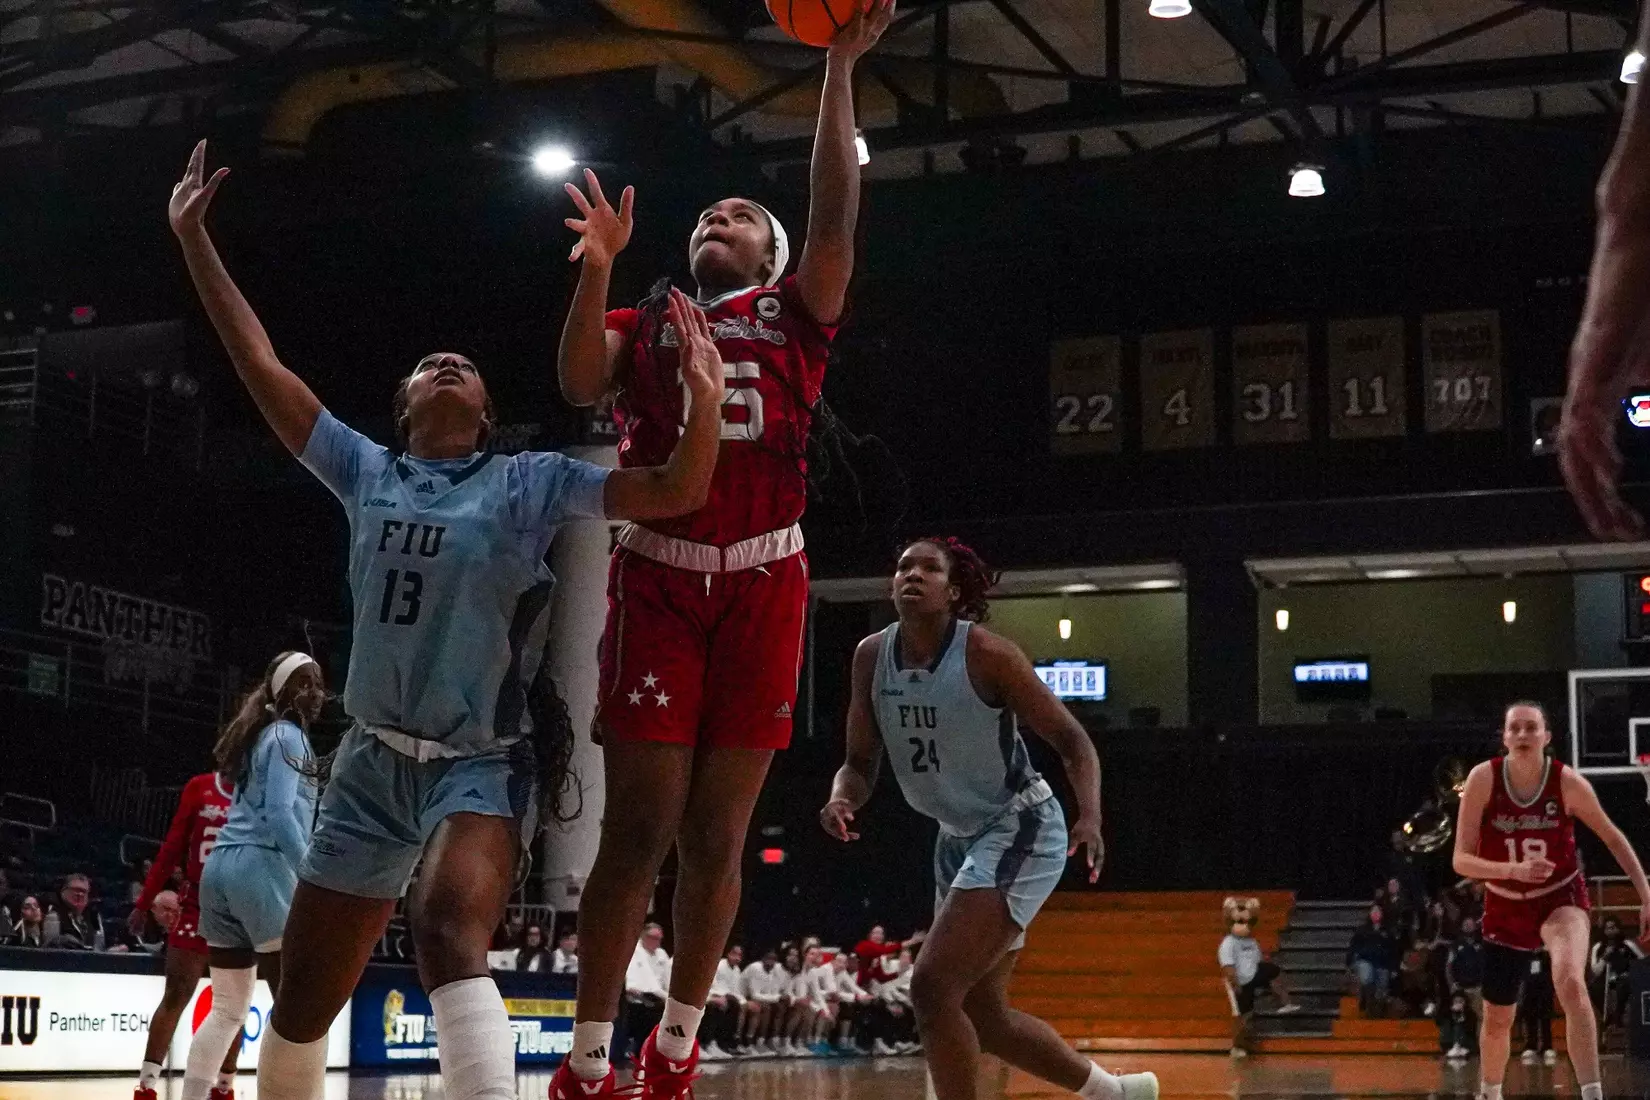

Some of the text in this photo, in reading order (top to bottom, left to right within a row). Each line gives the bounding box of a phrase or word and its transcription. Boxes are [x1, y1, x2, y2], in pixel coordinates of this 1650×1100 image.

[1163, 388, 1192, 425] 4
[1243, 380, 1299, 422] 31
[1343, 376, 1389, 417] 11
[1433, 376, 1492, 402] 707
[1055, 394, 1114, 434] 22
[378, 519, 446, 559] FIU
[41, 573, 213, 660] PANTHER
[379, 568, 424, 626] 13
[897, 705, 937, 729] FIU
[908, 737, 941, 773] 24
[49, 1012, 150, 1032] Panther TECH
